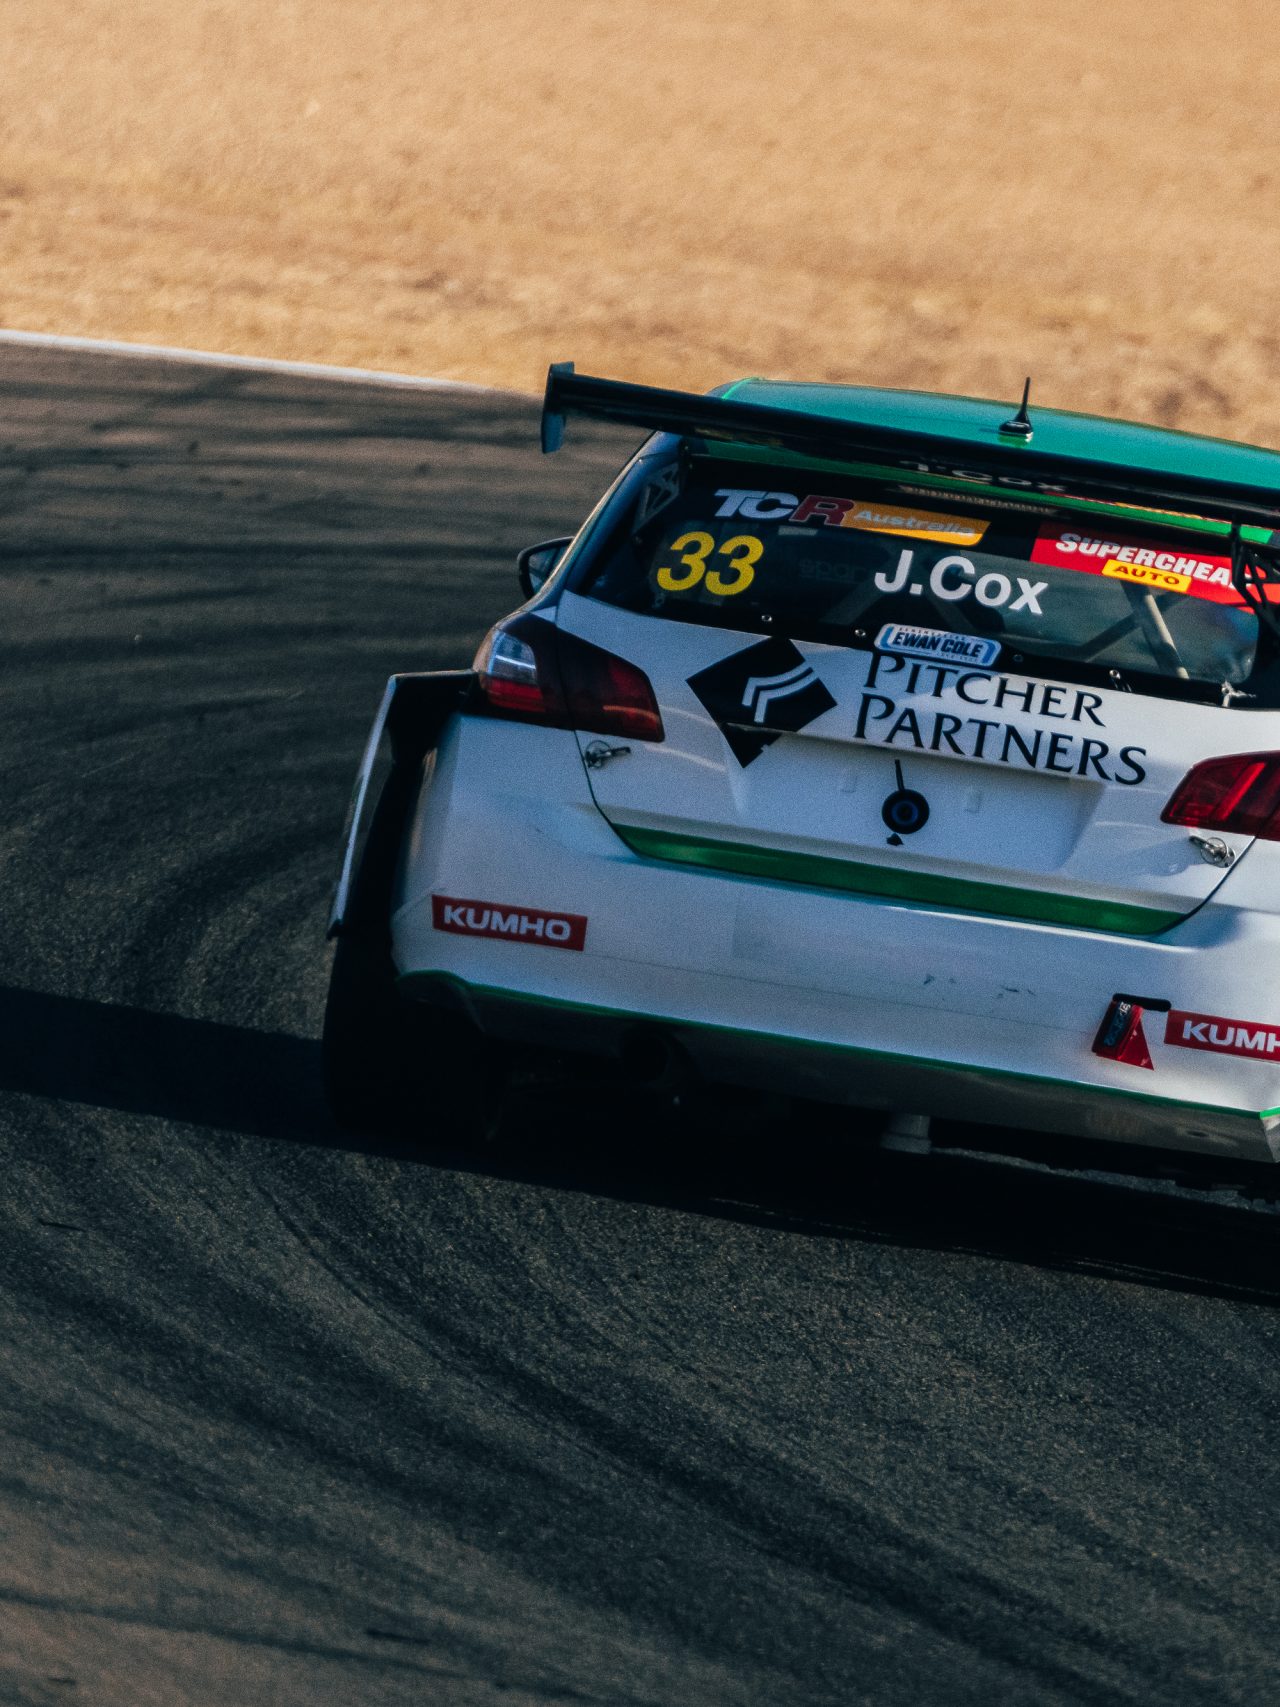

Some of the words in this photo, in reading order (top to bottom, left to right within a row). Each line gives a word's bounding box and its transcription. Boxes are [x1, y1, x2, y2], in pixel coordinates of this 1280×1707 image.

[714, 488, 855, 527] TCR
[852, 510, 976, 536] Australia
[657, 531, 764, 595] 33
[874, 549, 1048, 615] J.Cox
[1055, 532, 1252, 590] SUPERCHEA
[1112, 565, 1180, 586] AUTO
[891, 631, 941, 652] EWAN
[940, 637, 984, 659] COLE
[863, 651, 1107, 728] PITCHER
[853, 692, 1148, 786] PARTNERS
[444, 904, 571, 941] KUMHO
